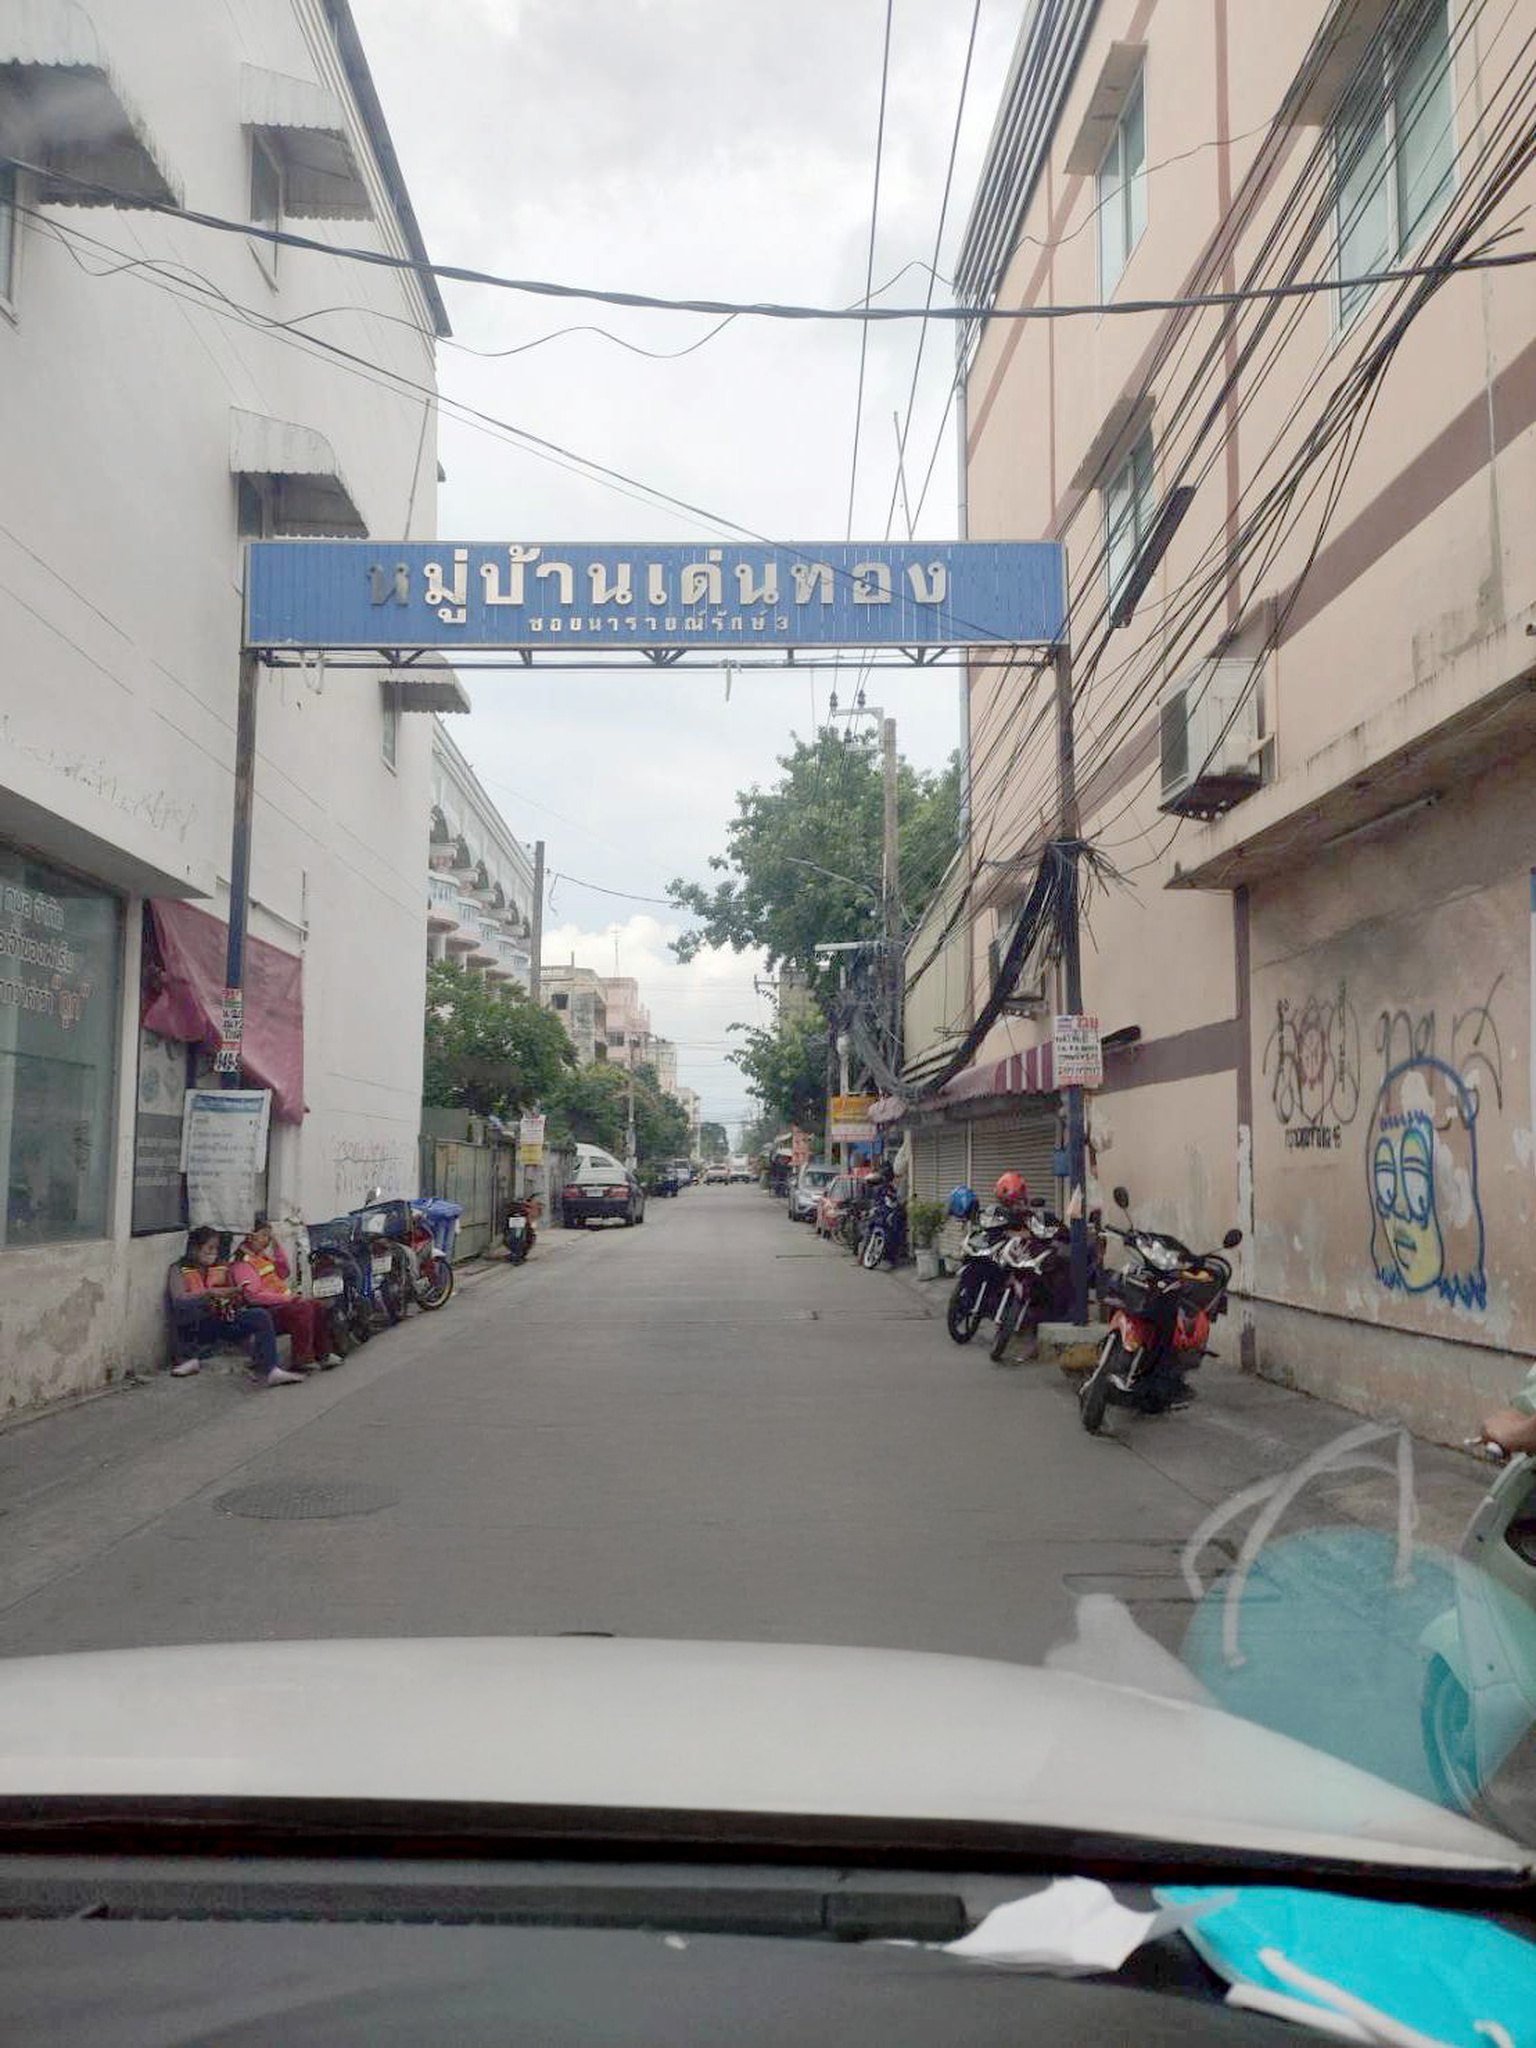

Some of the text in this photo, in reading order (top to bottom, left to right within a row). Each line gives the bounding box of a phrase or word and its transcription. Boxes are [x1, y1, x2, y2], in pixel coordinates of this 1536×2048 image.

[367, 545, 947, 624] หมู่บ้านเด่นทอง
